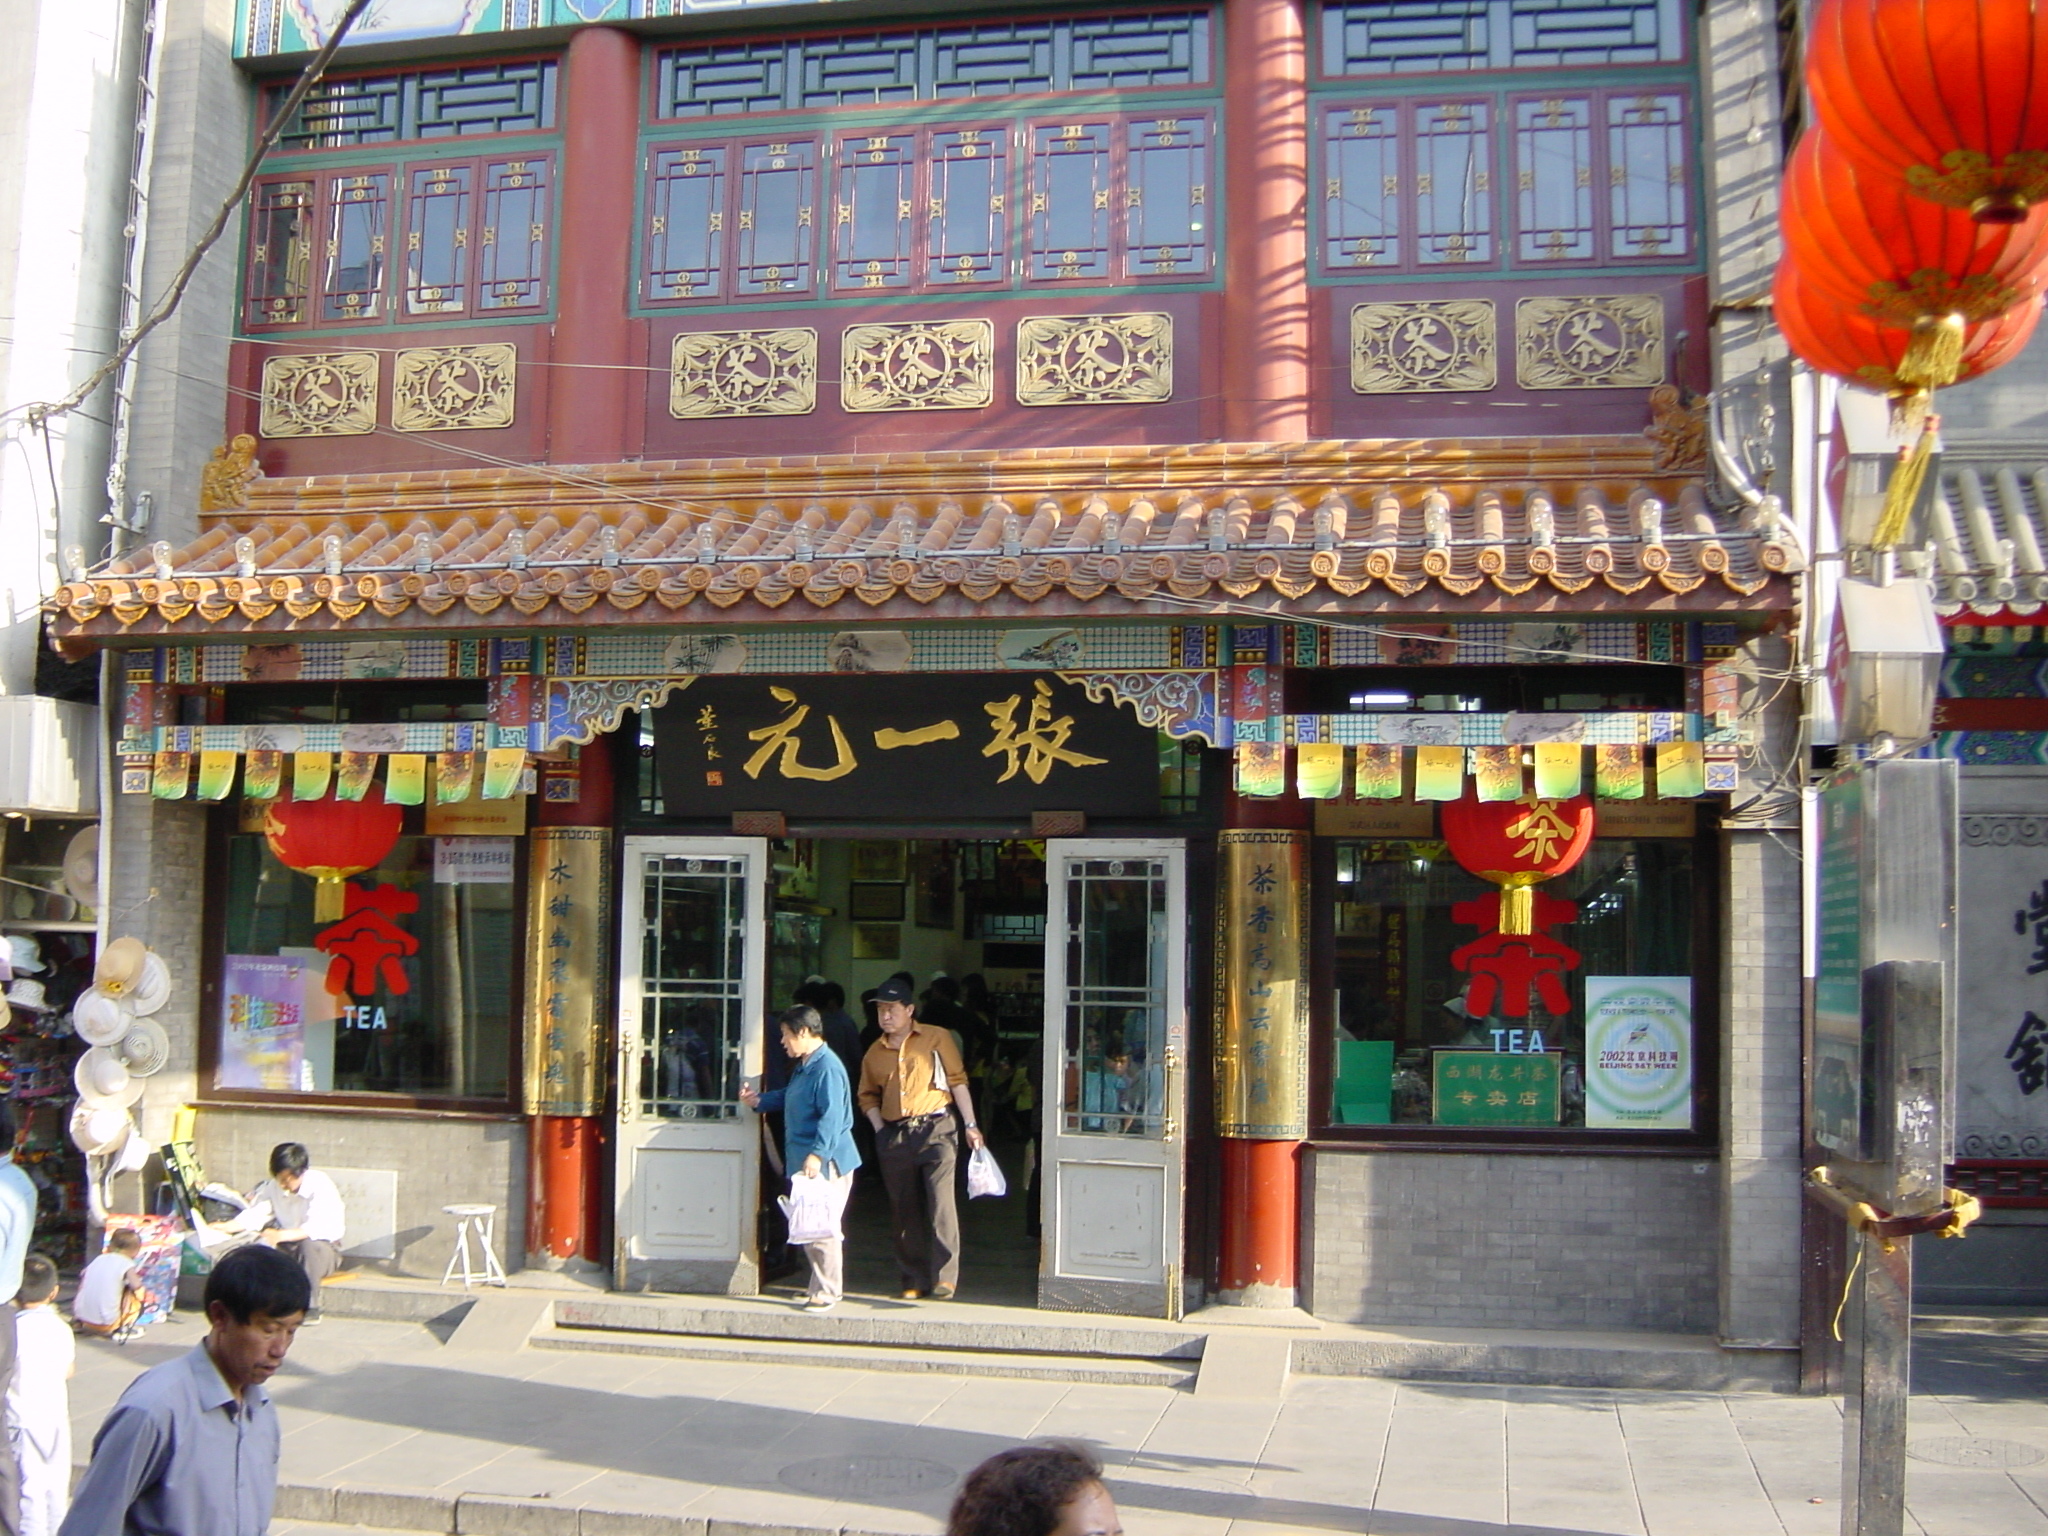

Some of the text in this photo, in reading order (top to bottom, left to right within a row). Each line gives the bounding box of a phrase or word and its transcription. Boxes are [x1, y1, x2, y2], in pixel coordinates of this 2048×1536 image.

[742, 678, 1110, 784] 張一元
[1505, 788, 1574, 865] 茶
[314, 881, 421, 997] 茶
[1450, 891, 1582, 1018] 茶
[343, 1005, 388, 1031] TEA
[1489, 1029, 1545, 1055] TEA
[1454, 1090, 1540, 1106] 专卖店
